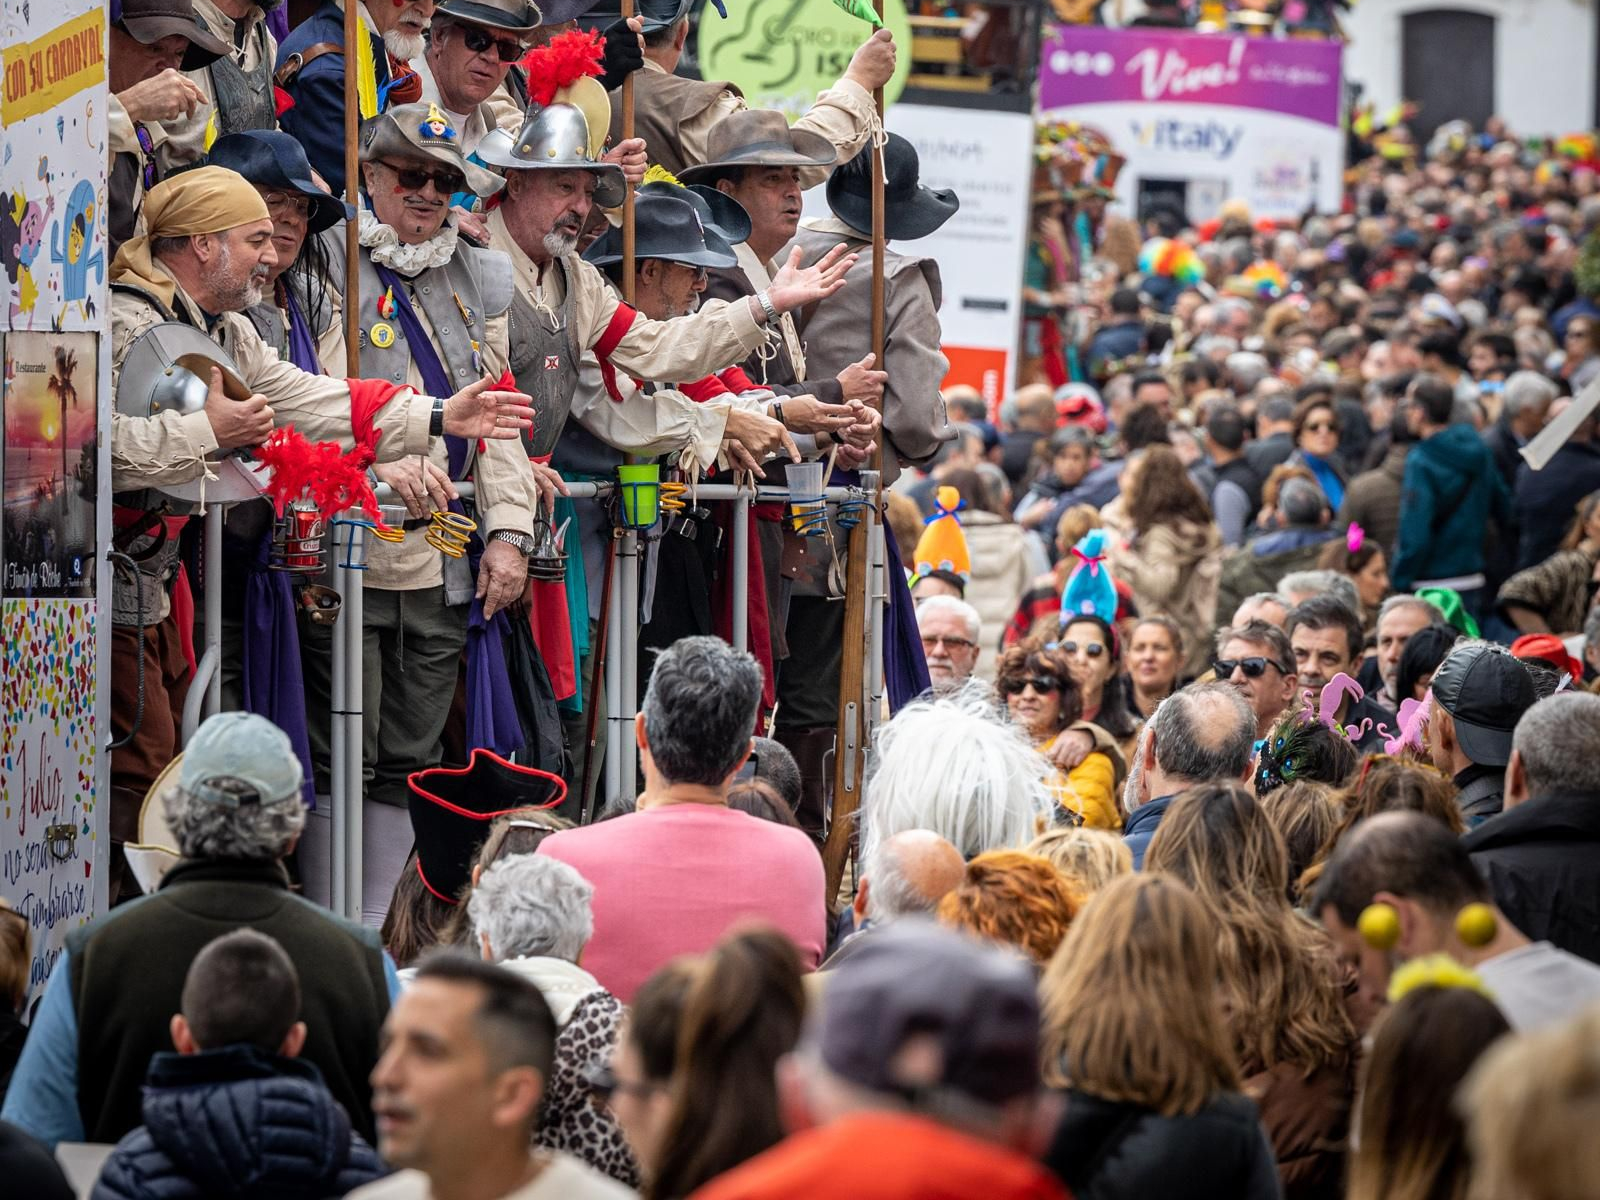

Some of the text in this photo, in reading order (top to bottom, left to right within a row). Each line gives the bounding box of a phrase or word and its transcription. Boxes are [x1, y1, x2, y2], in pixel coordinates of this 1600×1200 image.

[6, 24, 104, 103] CON SU CARNAVAL
[15, 360, 47, 373] Restaurante
